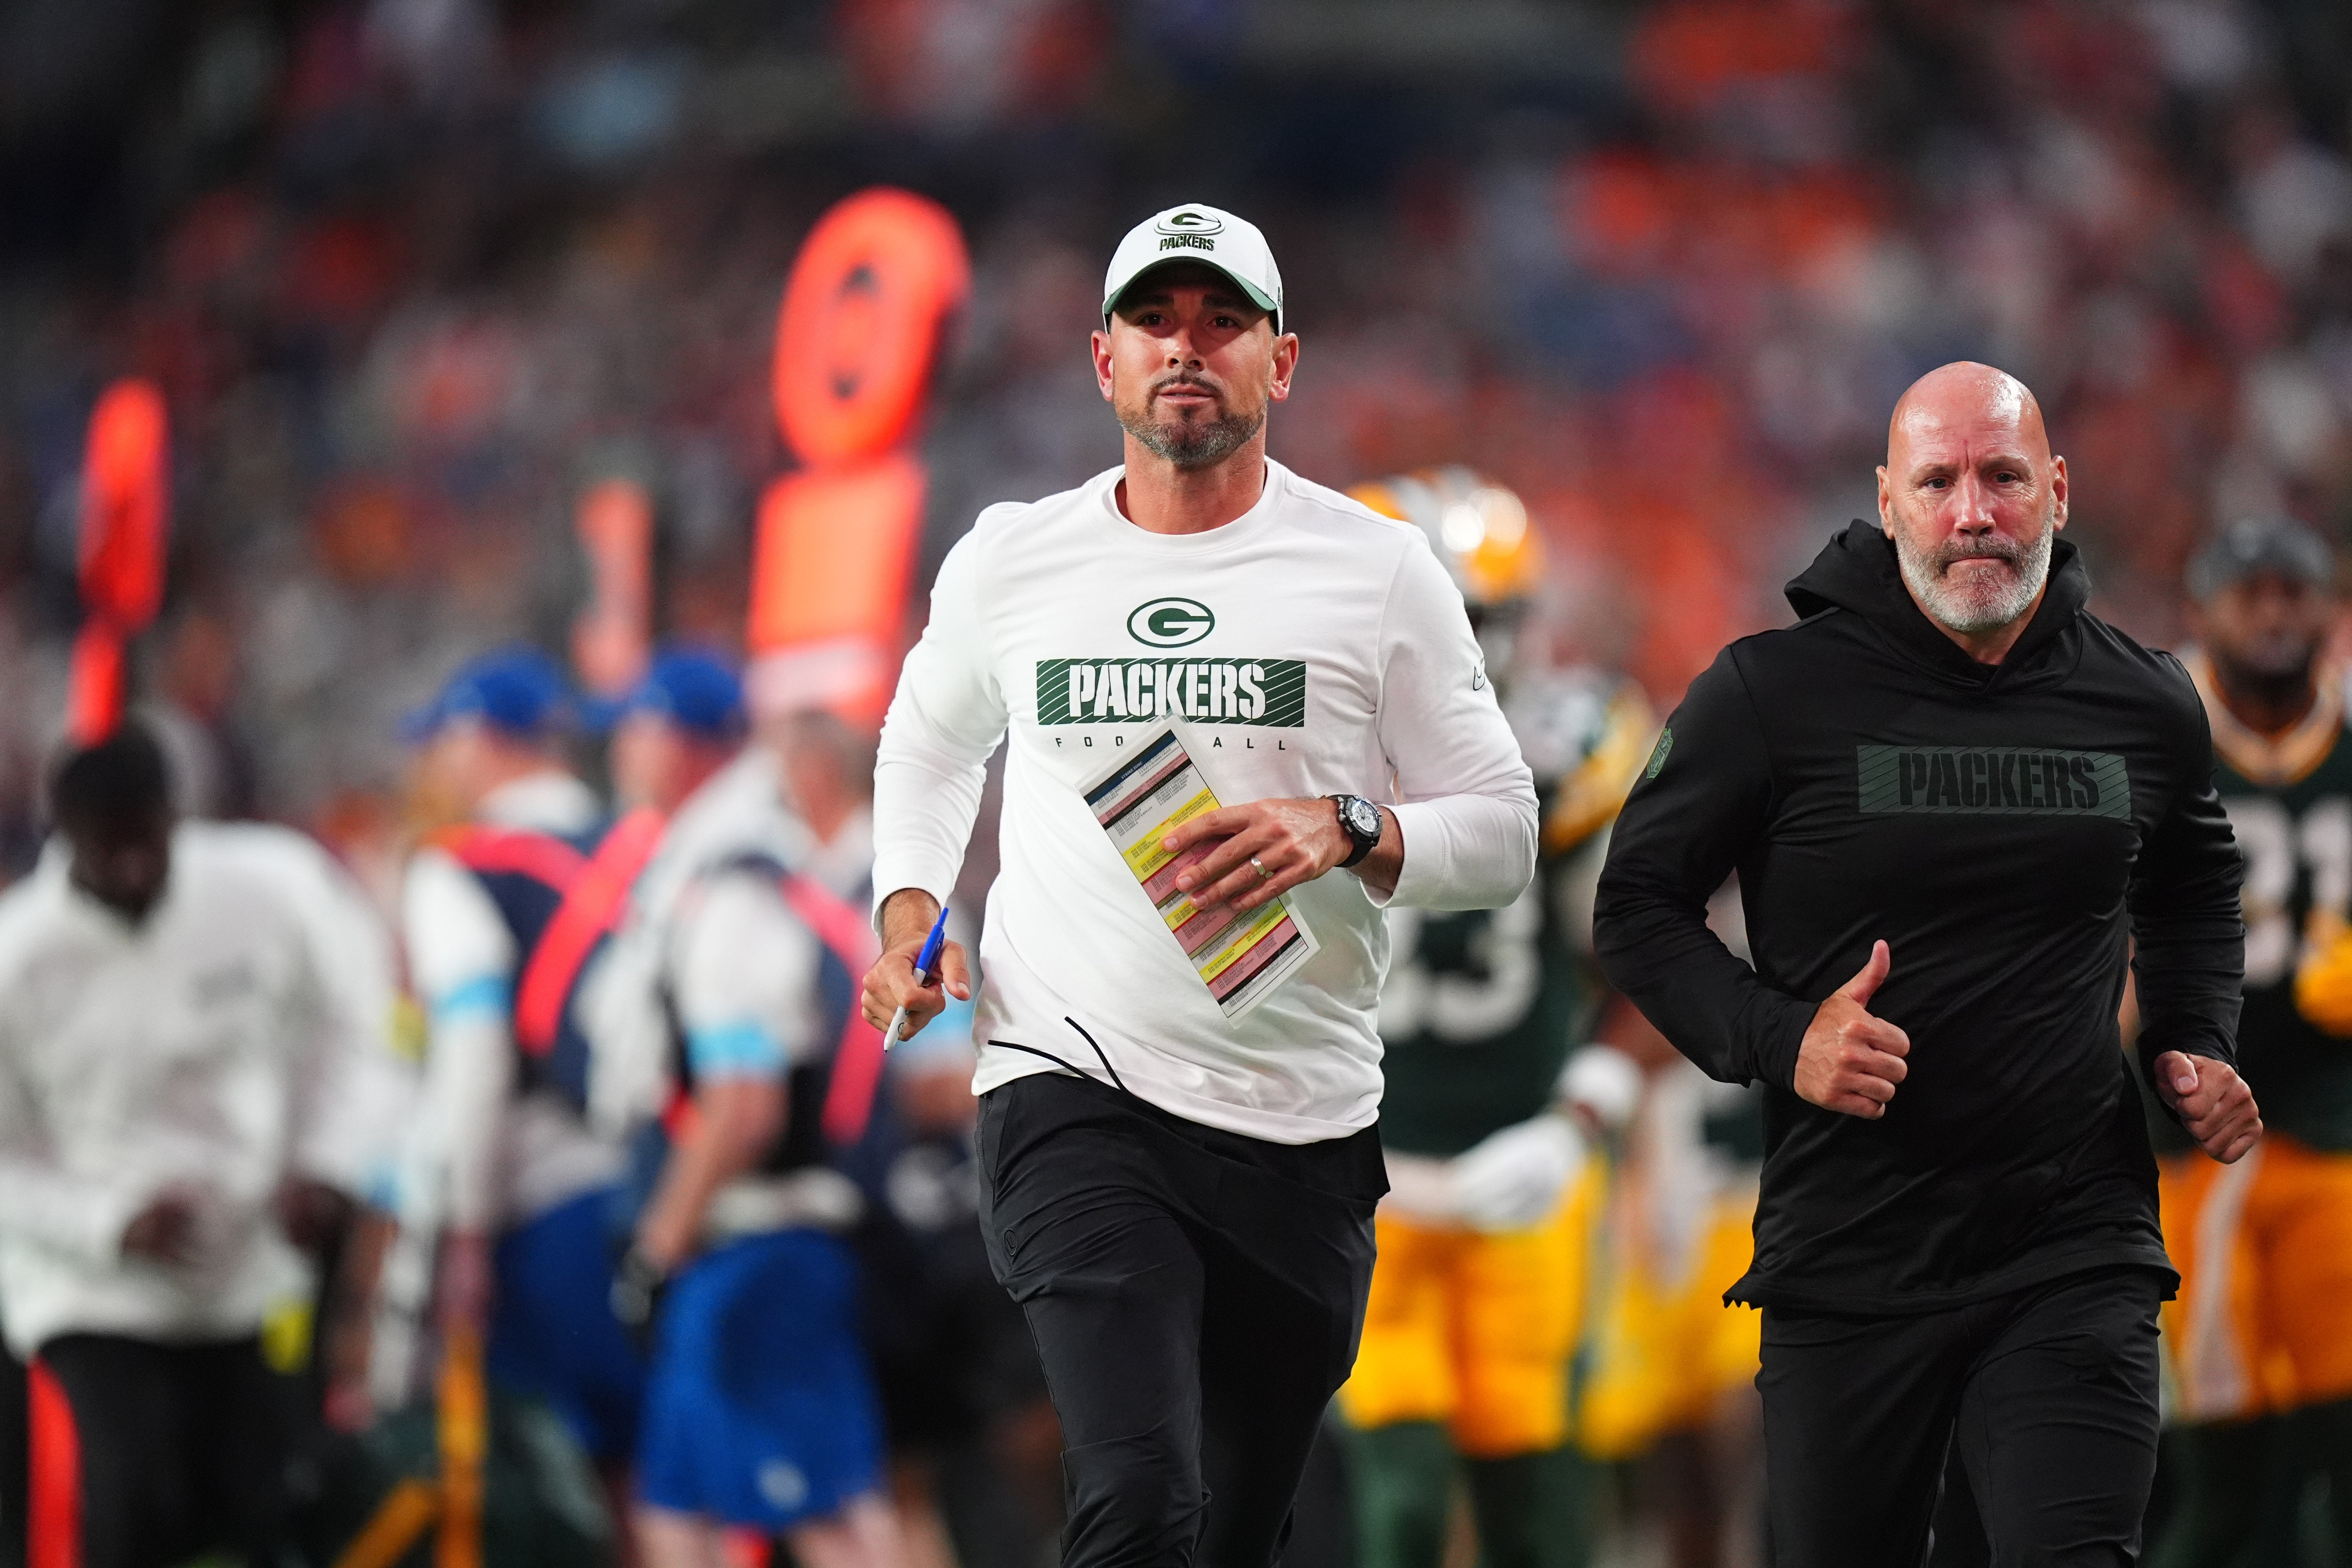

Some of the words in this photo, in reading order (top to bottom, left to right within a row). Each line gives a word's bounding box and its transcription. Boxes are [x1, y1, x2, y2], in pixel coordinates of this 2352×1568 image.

[1159, 235, 1215, 251] PACKERS
[1068, 663, 1266, 719] PACKERS
[1056, 735, 1286, 751] FOOALL
[1120, 768, 1134, 780] STRIKE
[1132, 761, 1143, 771] ZONE
[1899, 752, 2099, 809] PACKERS
